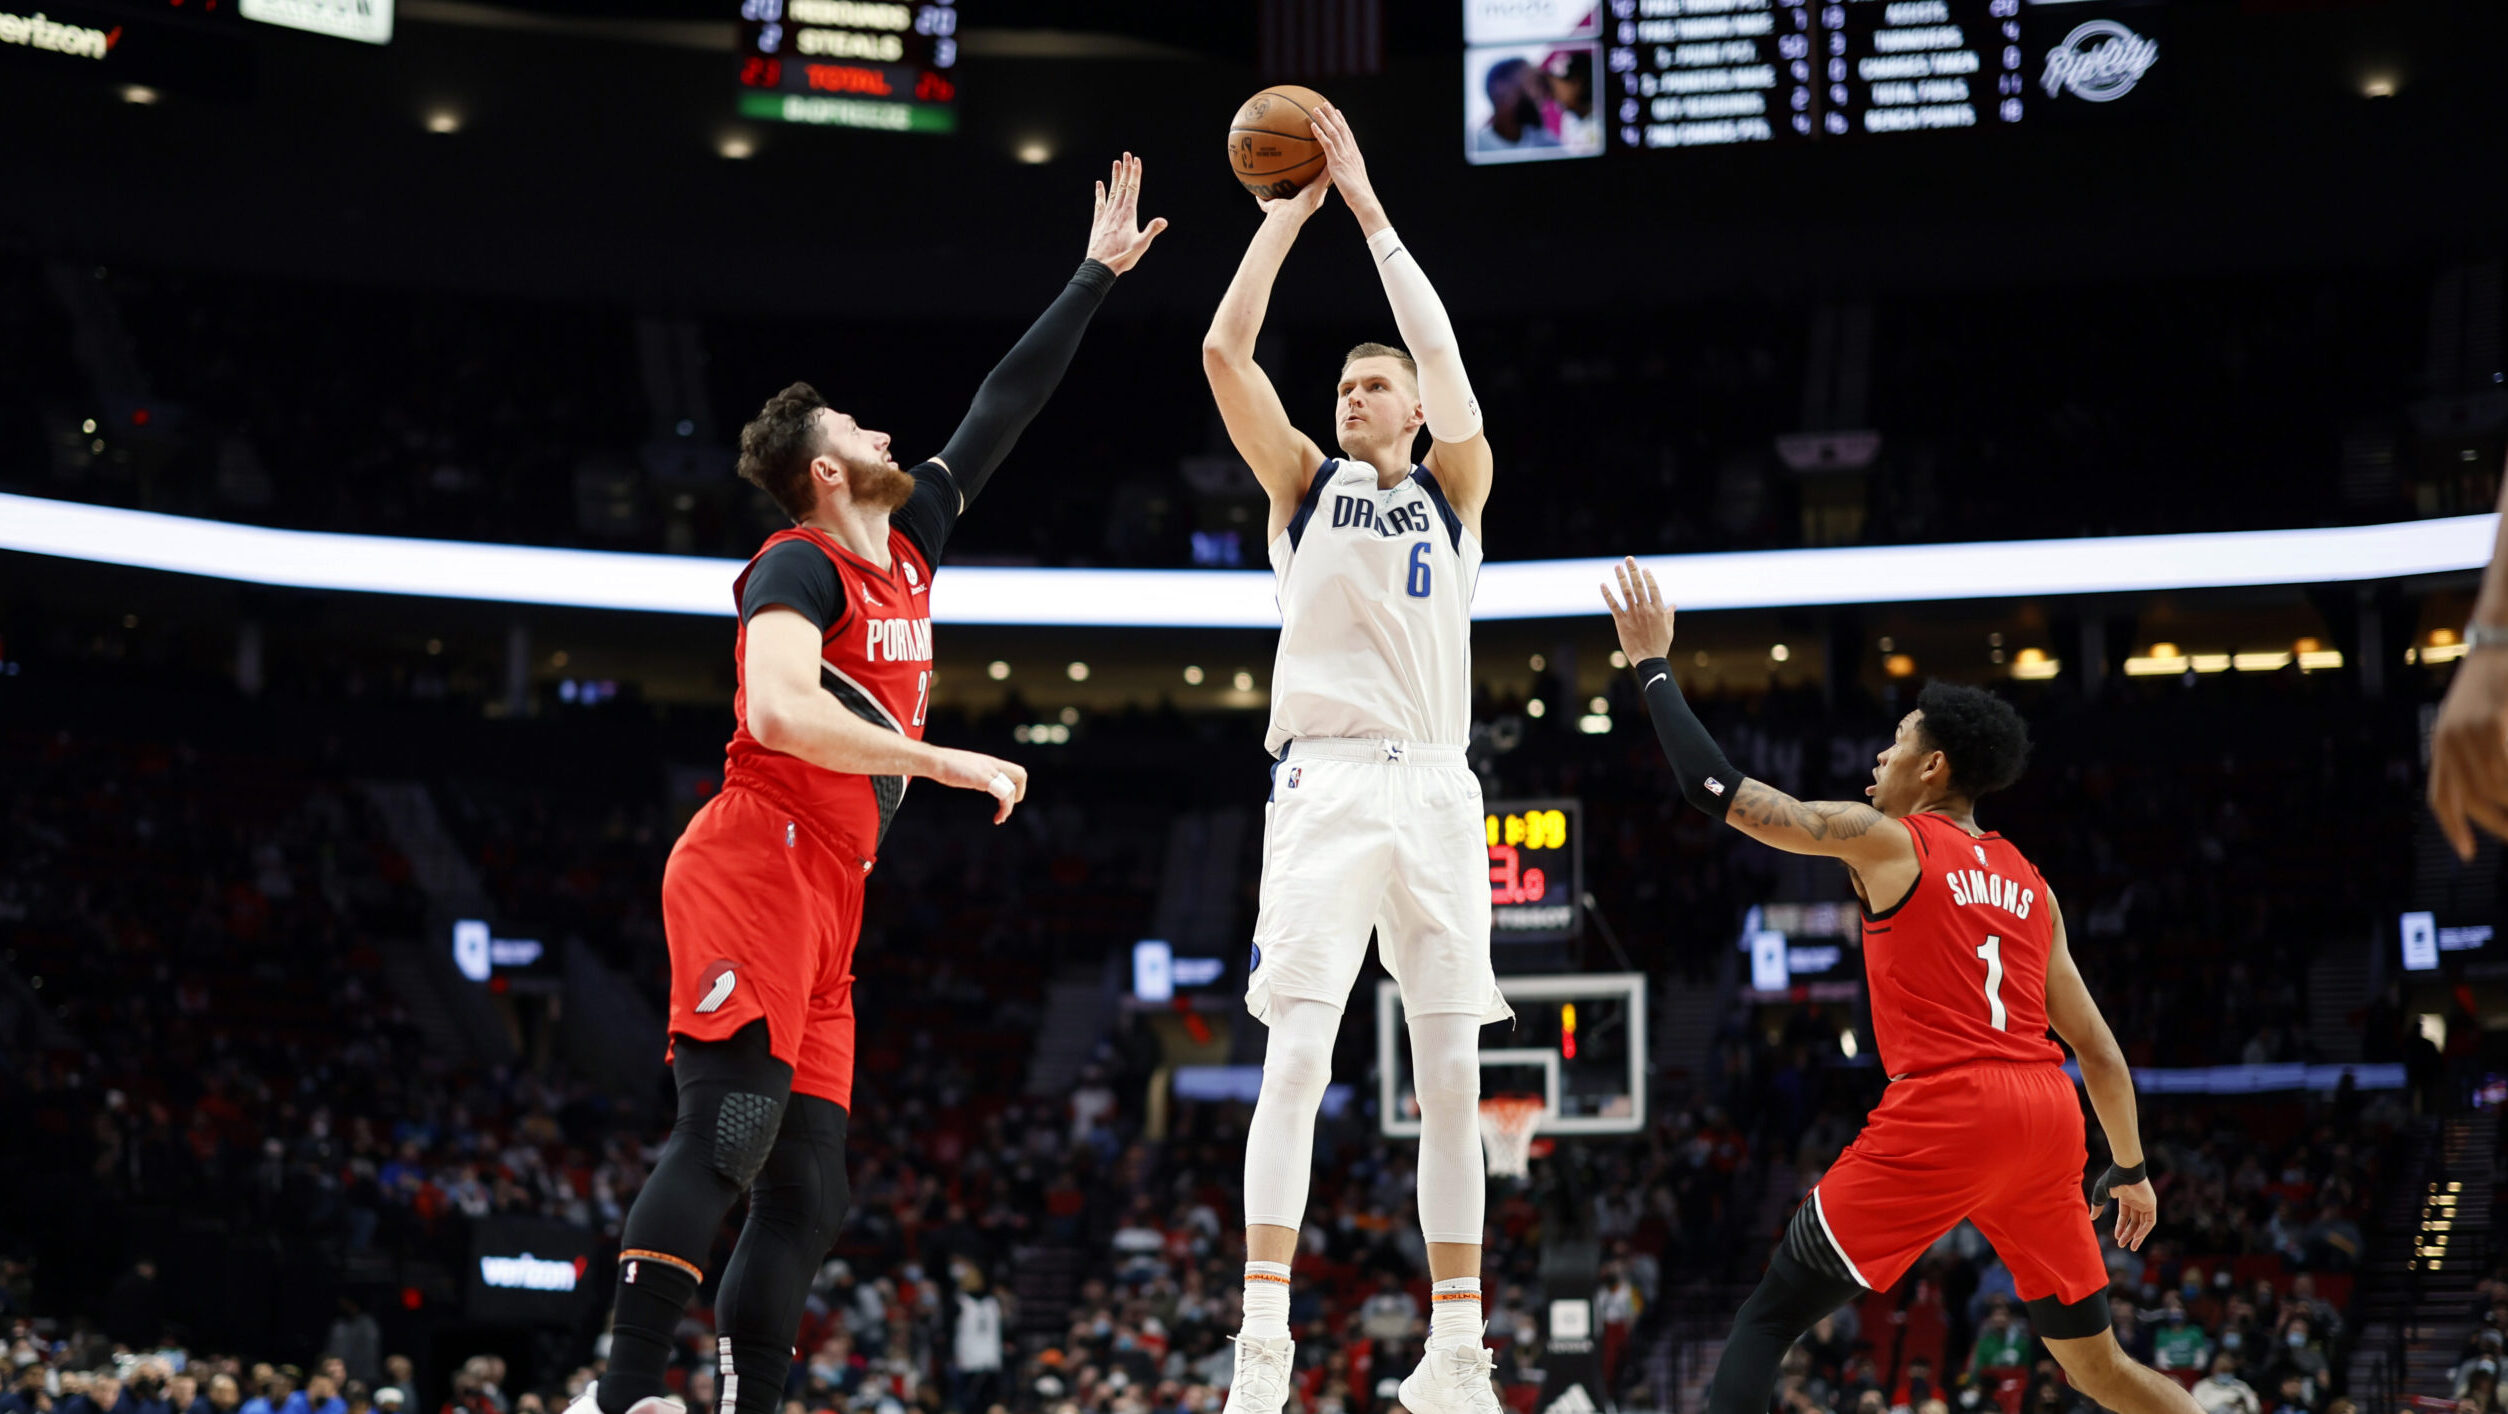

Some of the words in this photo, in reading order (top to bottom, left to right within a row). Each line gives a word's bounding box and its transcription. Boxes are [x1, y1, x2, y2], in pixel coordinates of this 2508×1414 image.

[797, 28, 903, 61] STEALS
[1332, 495, 1430, 537] DALAS
[1407, 541, 1431, 598] 6
[1946, 869, 2034, 921] SIMONS
[1976, 934, 2008, 1033] 1
